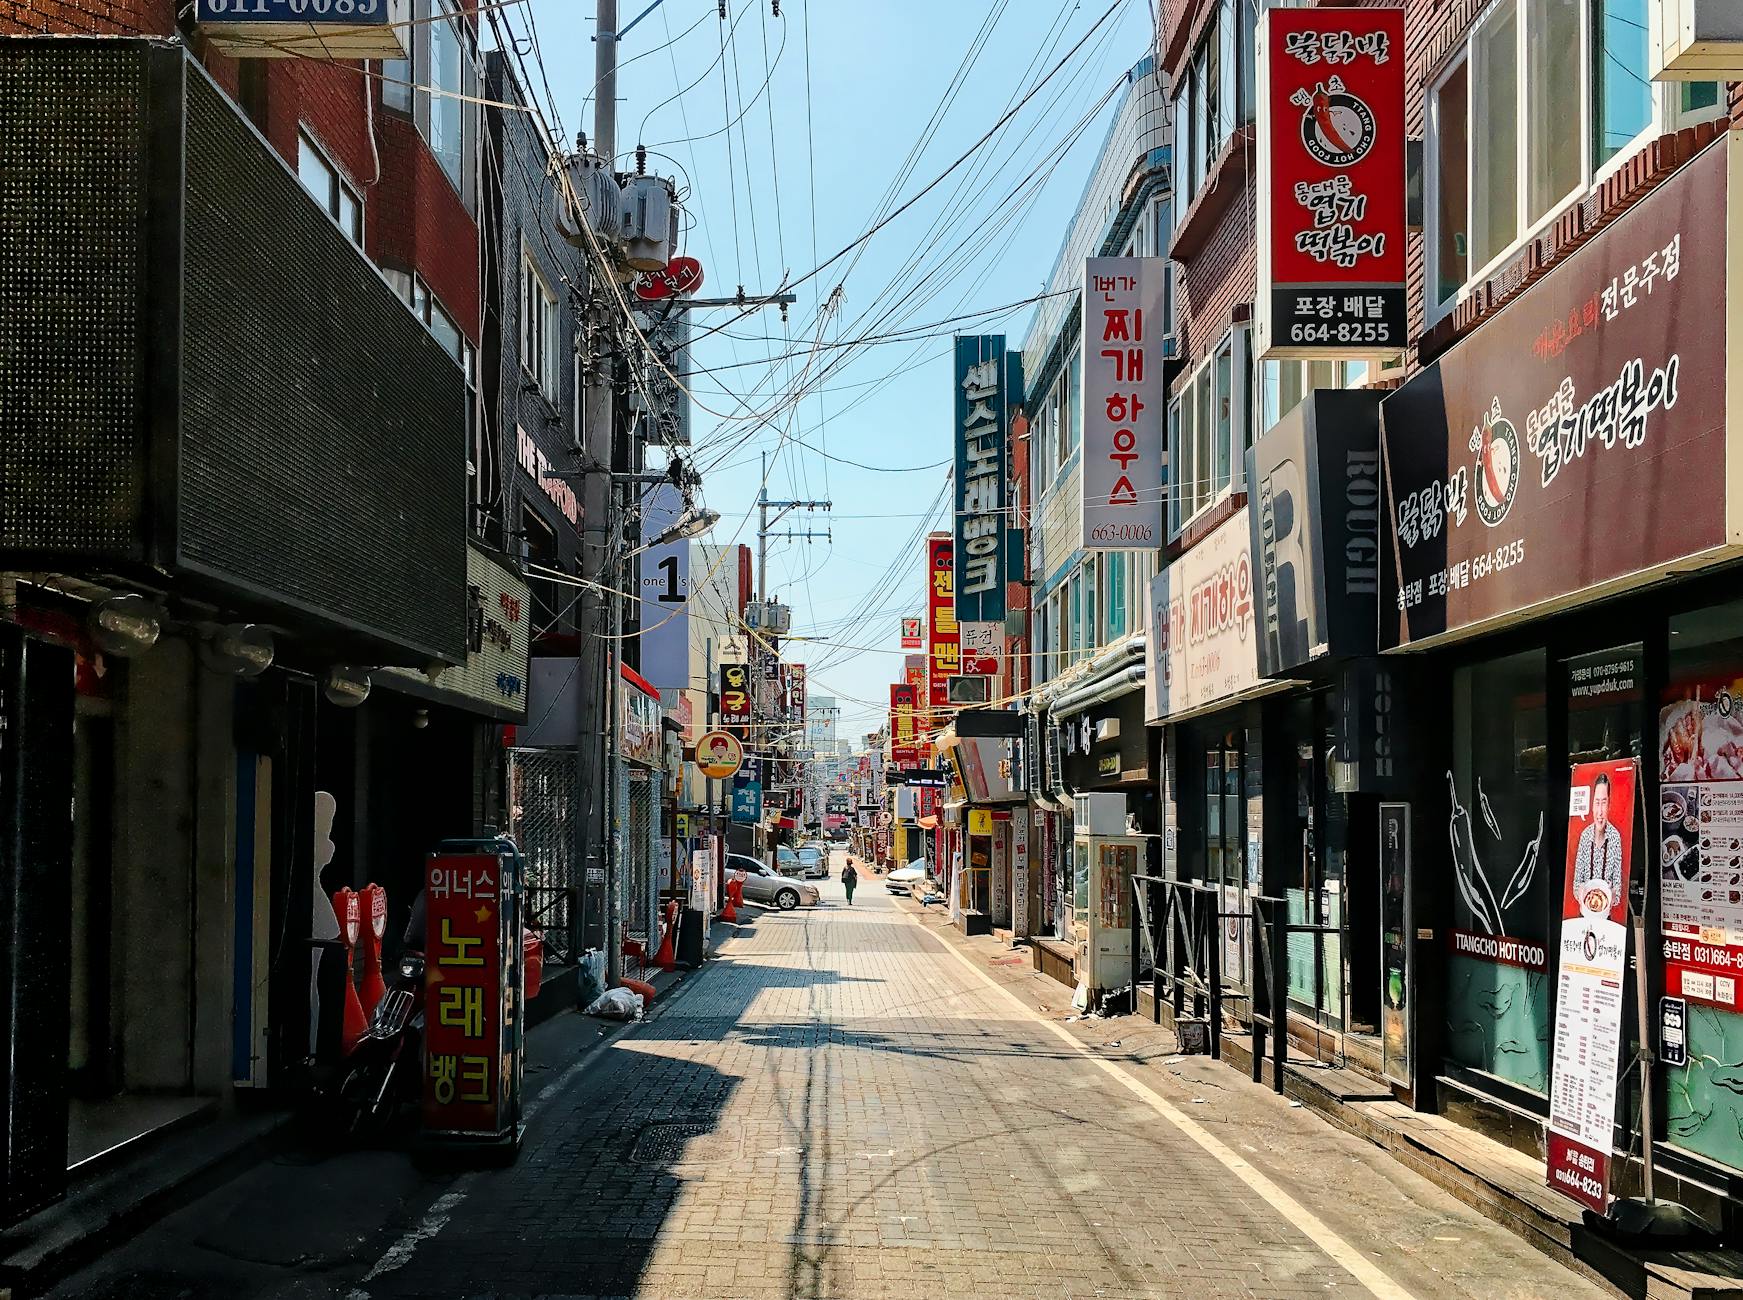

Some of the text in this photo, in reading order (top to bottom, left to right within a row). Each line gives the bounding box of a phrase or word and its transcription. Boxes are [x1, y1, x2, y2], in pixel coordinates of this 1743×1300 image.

[1286, 31, 1390, 65] 불닭발
[1308, 139, 1331, 161] FOOD
[1333, 152, 1355, 163] HOT
[1295, 224, 1386, 268] 떡볶이
[1601, 233, 1681, 322] 전문주점
[1294, 295, 1386, 319] 포장.배달
[1290, 322, 1390, 343] 664-8255
[517, 423, 536, 480] THE
[1091, 523, 1153, 542] 663-0006
[1346, 450, 1378, 595] ROUGH
[1472, 538, 1525, 581] 664-8255
[430, 868, 495, 899] 위너스
[1455, 932, 1545, 967] TTANGCHO HOT FOOD
[1662, 939, 1691, 962] 송탄점
[431, 917, 490, 1105] 노래뱅크
